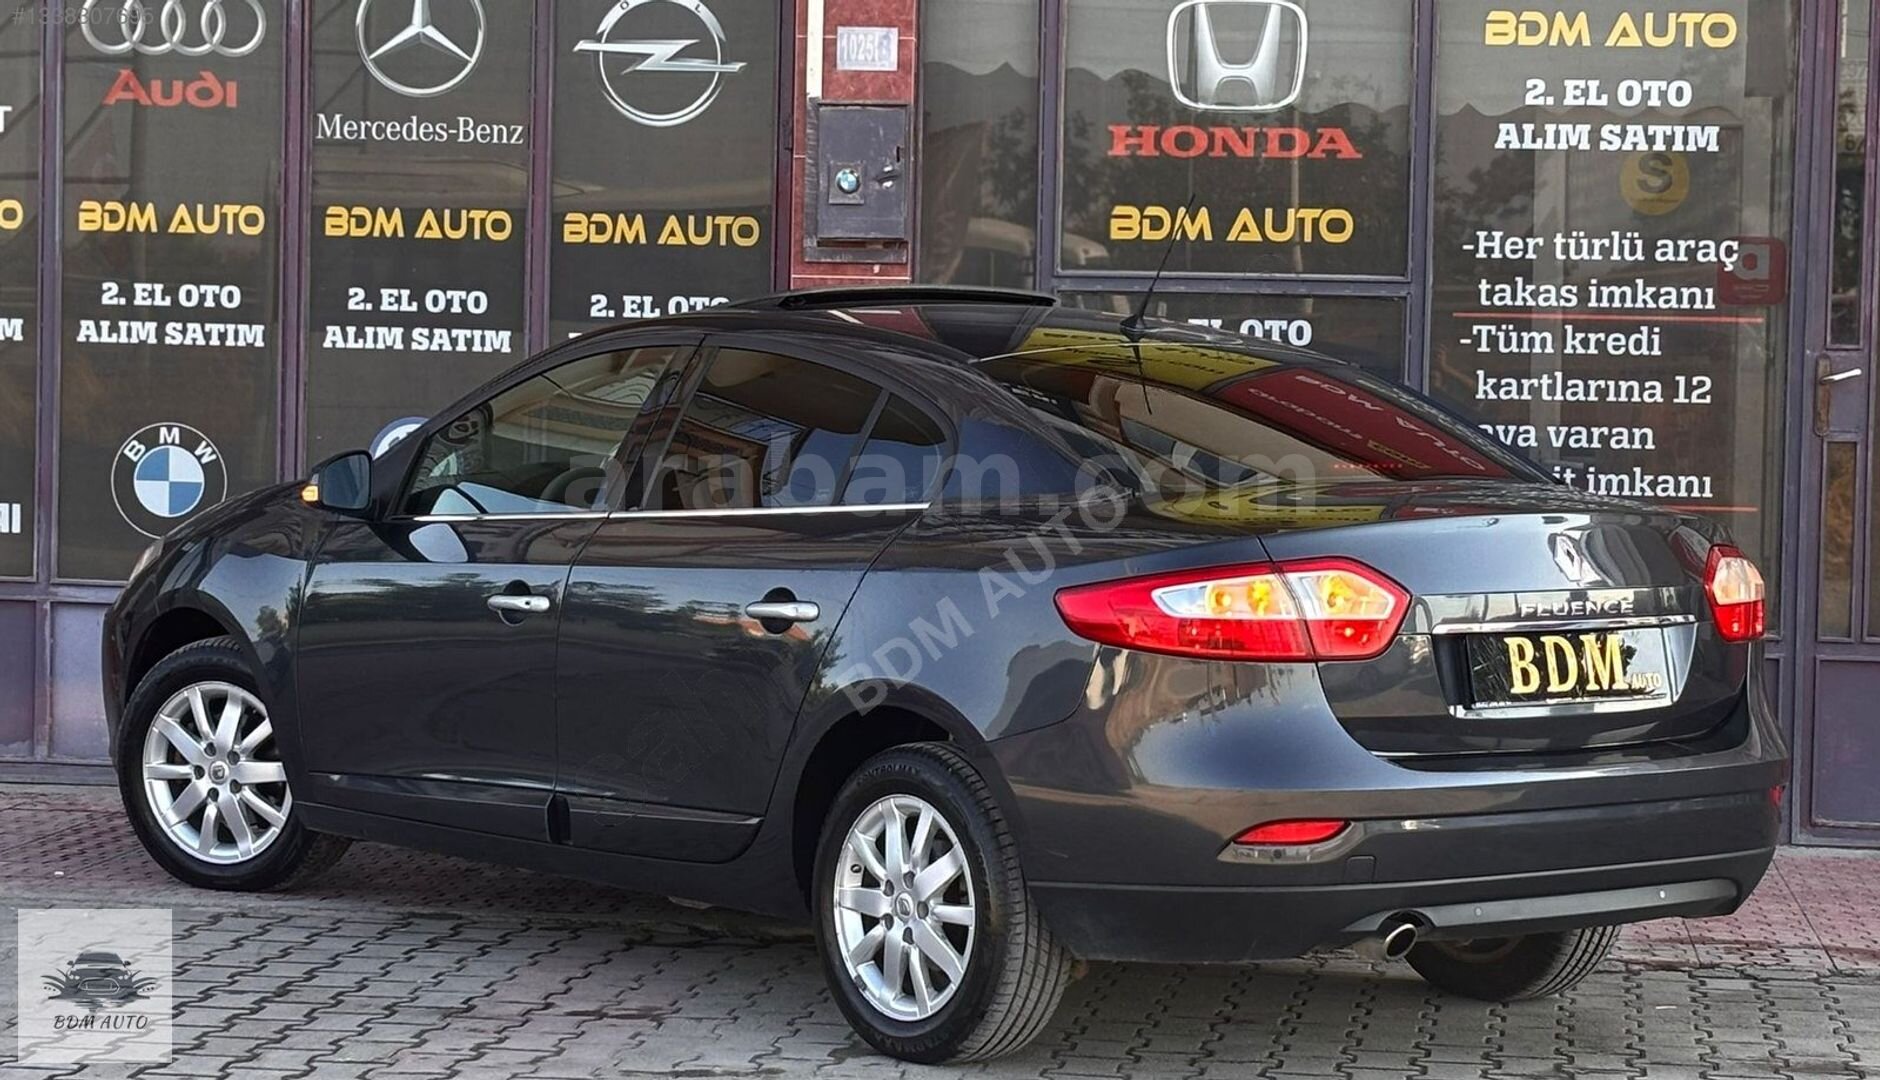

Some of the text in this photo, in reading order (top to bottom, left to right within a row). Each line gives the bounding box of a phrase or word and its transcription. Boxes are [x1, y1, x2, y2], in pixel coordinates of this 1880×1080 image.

[1485, 11, 1738, 48] BDM AUTO
[104, 69, 238, 108] Audi
[1525, 79, 1692, 108] 2. EL OTO
[316, 113, 524, 145] Mercedes-Benz
[1107, 124, 1362, 160] HONDA
[1495, 123, 1720, 153] ALIM SATIM
[78, 200, 265, 236] BDM AUTO
[324, 206, 513, 241] BDM AUTO
[562, 211, 760, 247] BDM AUTO
[1109, 204, 1355, 244] BDM AUTO
[1462, 230, 1739, 272] -Her türlü araç
[101, 281, 241, 309] 2. EL OTO
[347, 287, 488, 315] 2. EL OTO
[590, 294, 615, 318] 2.
[622, 295, 661, 319] EL
[1478, 276, 1578, 308] takas
[1587, 278, 1716, 310] imkanı
[76, 319, 266, 348] ALIM SATIM
[322, 325, 513, 353] ALIM SATIM
[1240, 319, 1313, 346] OTO
[1459, 324, 1662, 357] -Tüm kredi
[1475, 369, 1712, 404] kartlarına 12
[124, 426, 218, 465] BMW
[1546, 426, 1656, 450] varan
[1586, 467, 1713, 498] imkanı
[1520, 600, 1634, 618] FLUENCE
[1503, 632, 1662, 694] BDM AUTO
